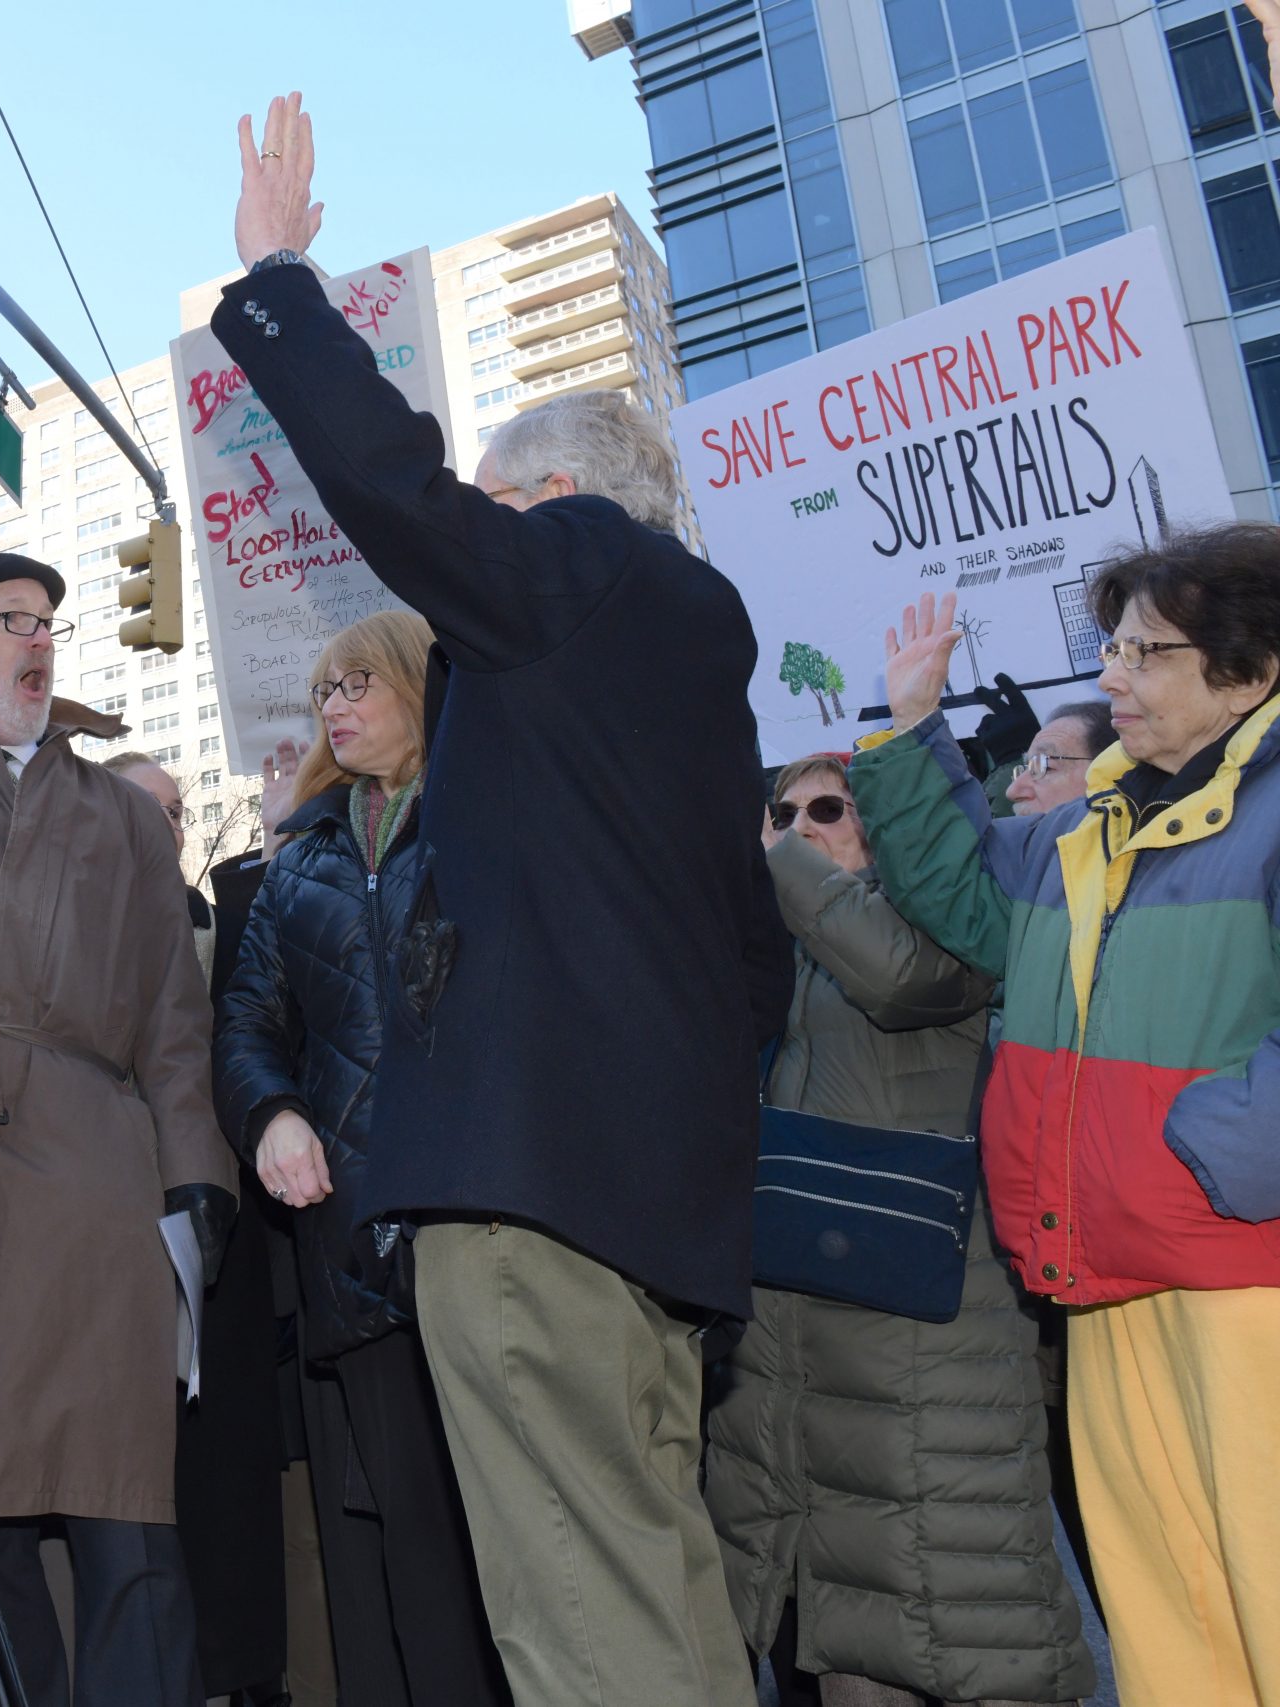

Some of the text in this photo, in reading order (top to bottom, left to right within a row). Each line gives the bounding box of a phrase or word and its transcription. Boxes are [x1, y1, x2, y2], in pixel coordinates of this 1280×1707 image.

[375, 345, 415, 372] SED
[701, 279, 1143, 489] SAVE CENTRAL PARK
[790, 396, 1117, 557] FROM SUPERTALLS
[920, 537, 1065, 578] AND THEIR SHADOWS
